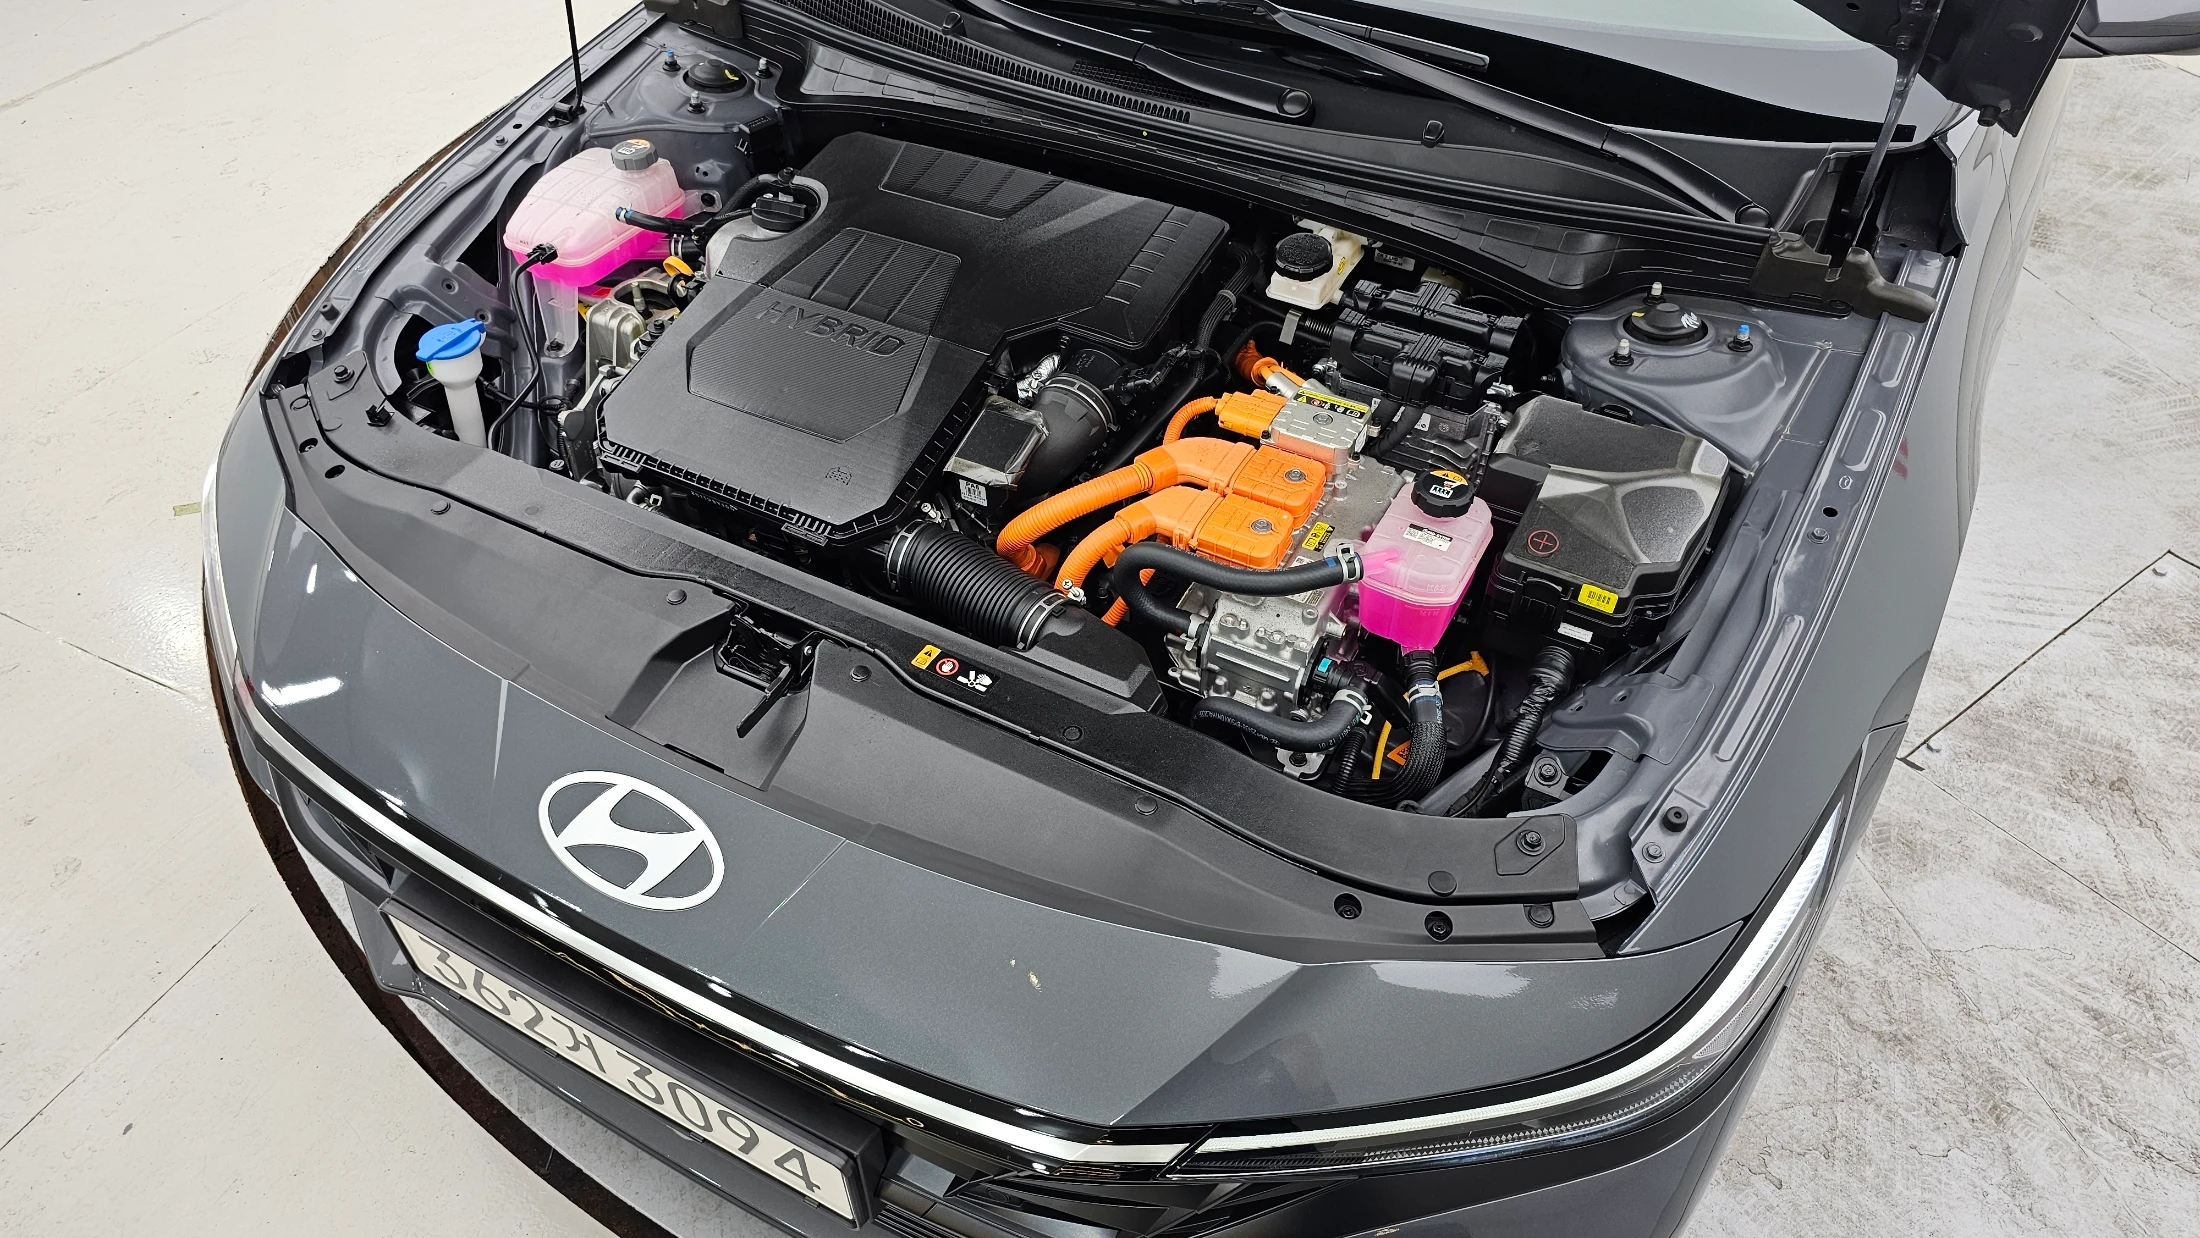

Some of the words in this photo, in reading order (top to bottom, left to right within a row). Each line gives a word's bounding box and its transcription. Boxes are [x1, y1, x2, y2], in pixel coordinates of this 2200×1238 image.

[756, 301, 906, 357] HYBRID
[418, 935, 607, 1074] 362거
[616, 1050, 821, 1193] 3094
